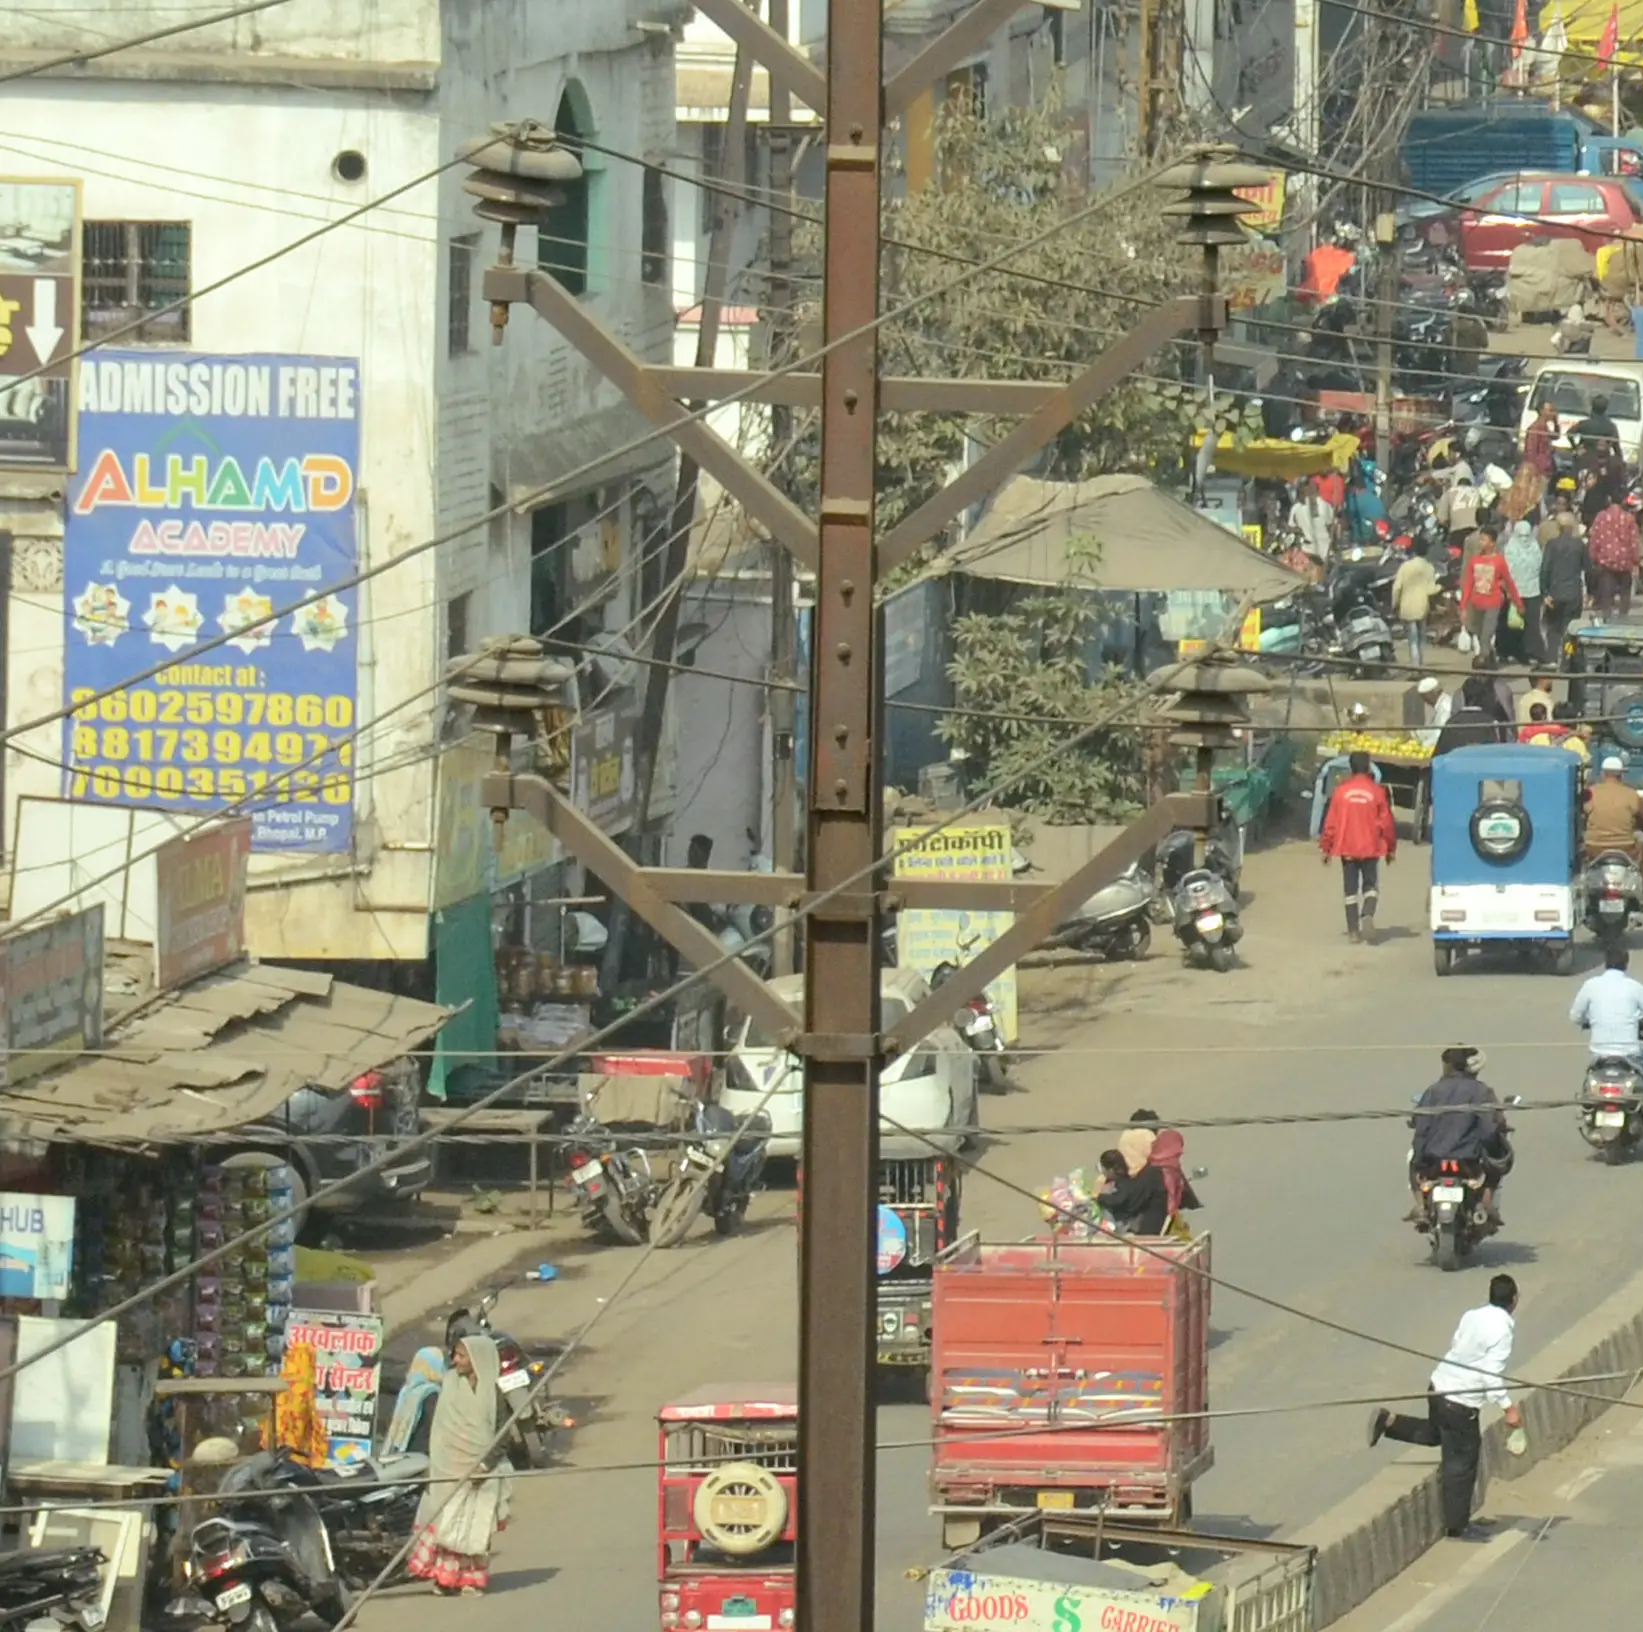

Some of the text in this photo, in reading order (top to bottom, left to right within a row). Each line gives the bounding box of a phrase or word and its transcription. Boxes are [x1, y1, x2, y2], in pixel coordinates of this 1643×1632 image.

[78, 360, 355, 419] ADMISSION FREE
[74, 448, 352, 515] ALHAMD
[128, 519, 306, 558] ACADEMY
[949, 1594, 1029, 1621] GOODS
